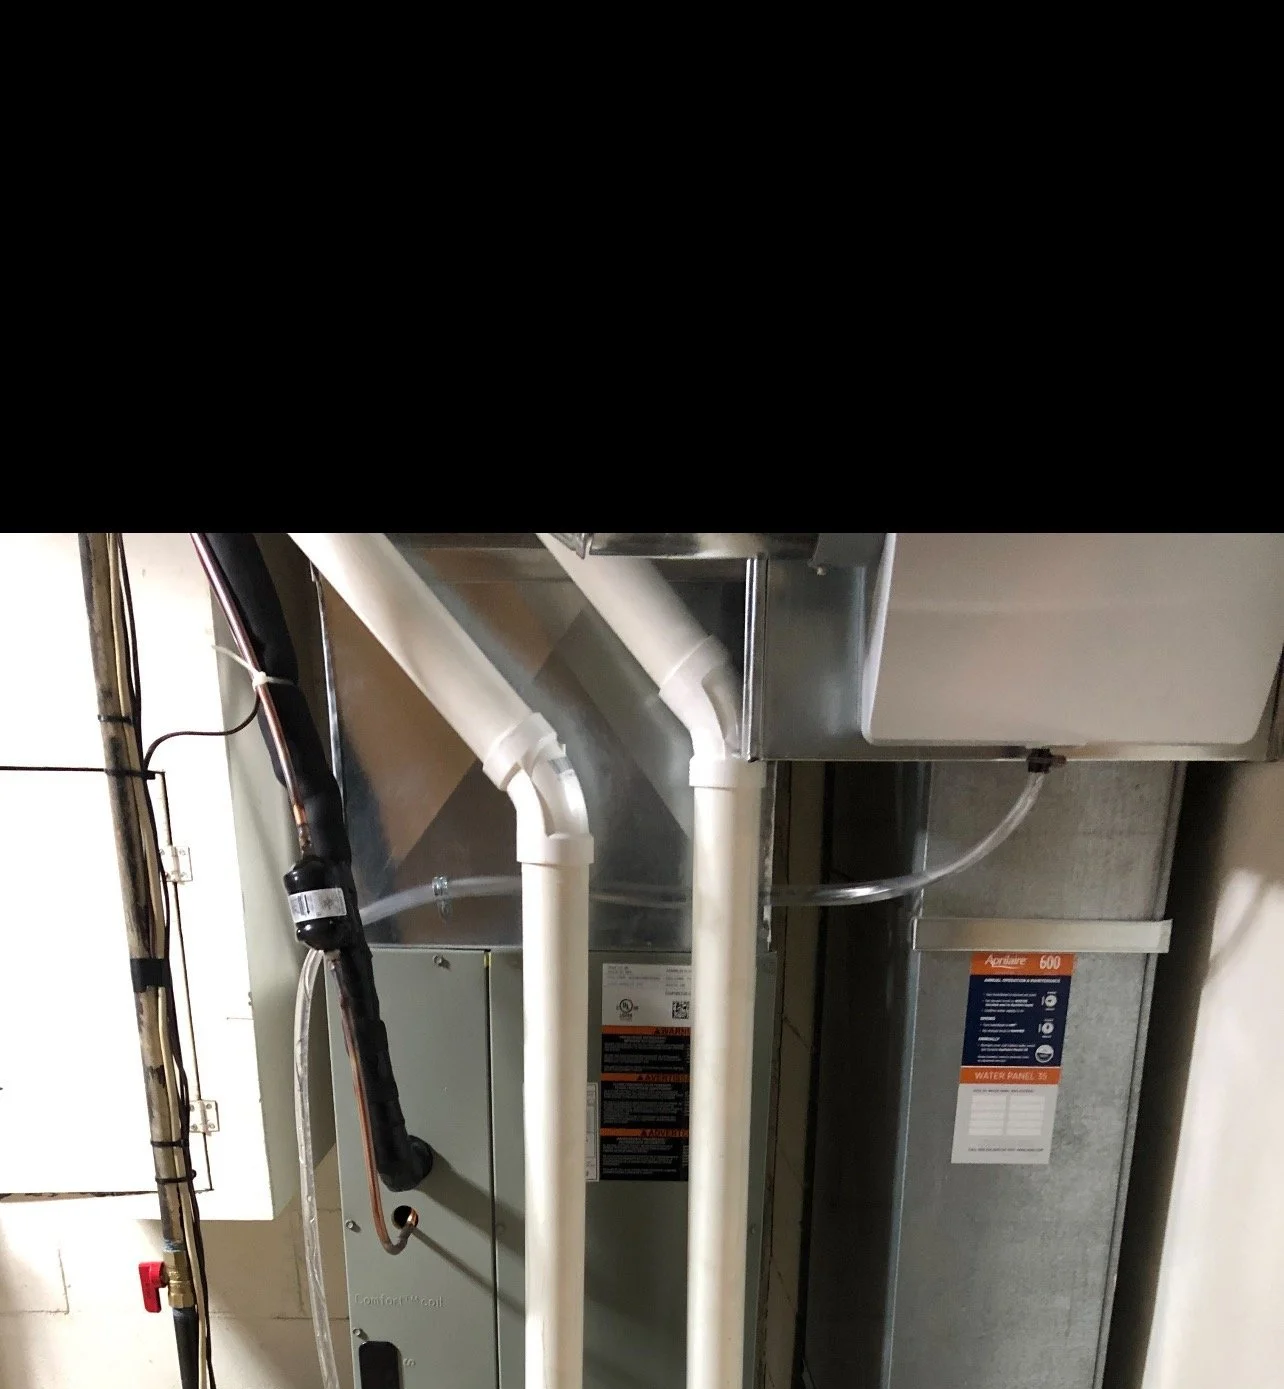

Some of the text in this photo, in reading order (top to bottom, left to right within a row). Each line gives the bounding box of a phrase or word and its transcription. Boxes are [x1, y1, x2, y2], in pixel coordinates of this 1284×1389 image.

[984, 954, 1061, 969] Aprilaire 600
[974, 1071, 1048, 1081] WATER PANEL 35
